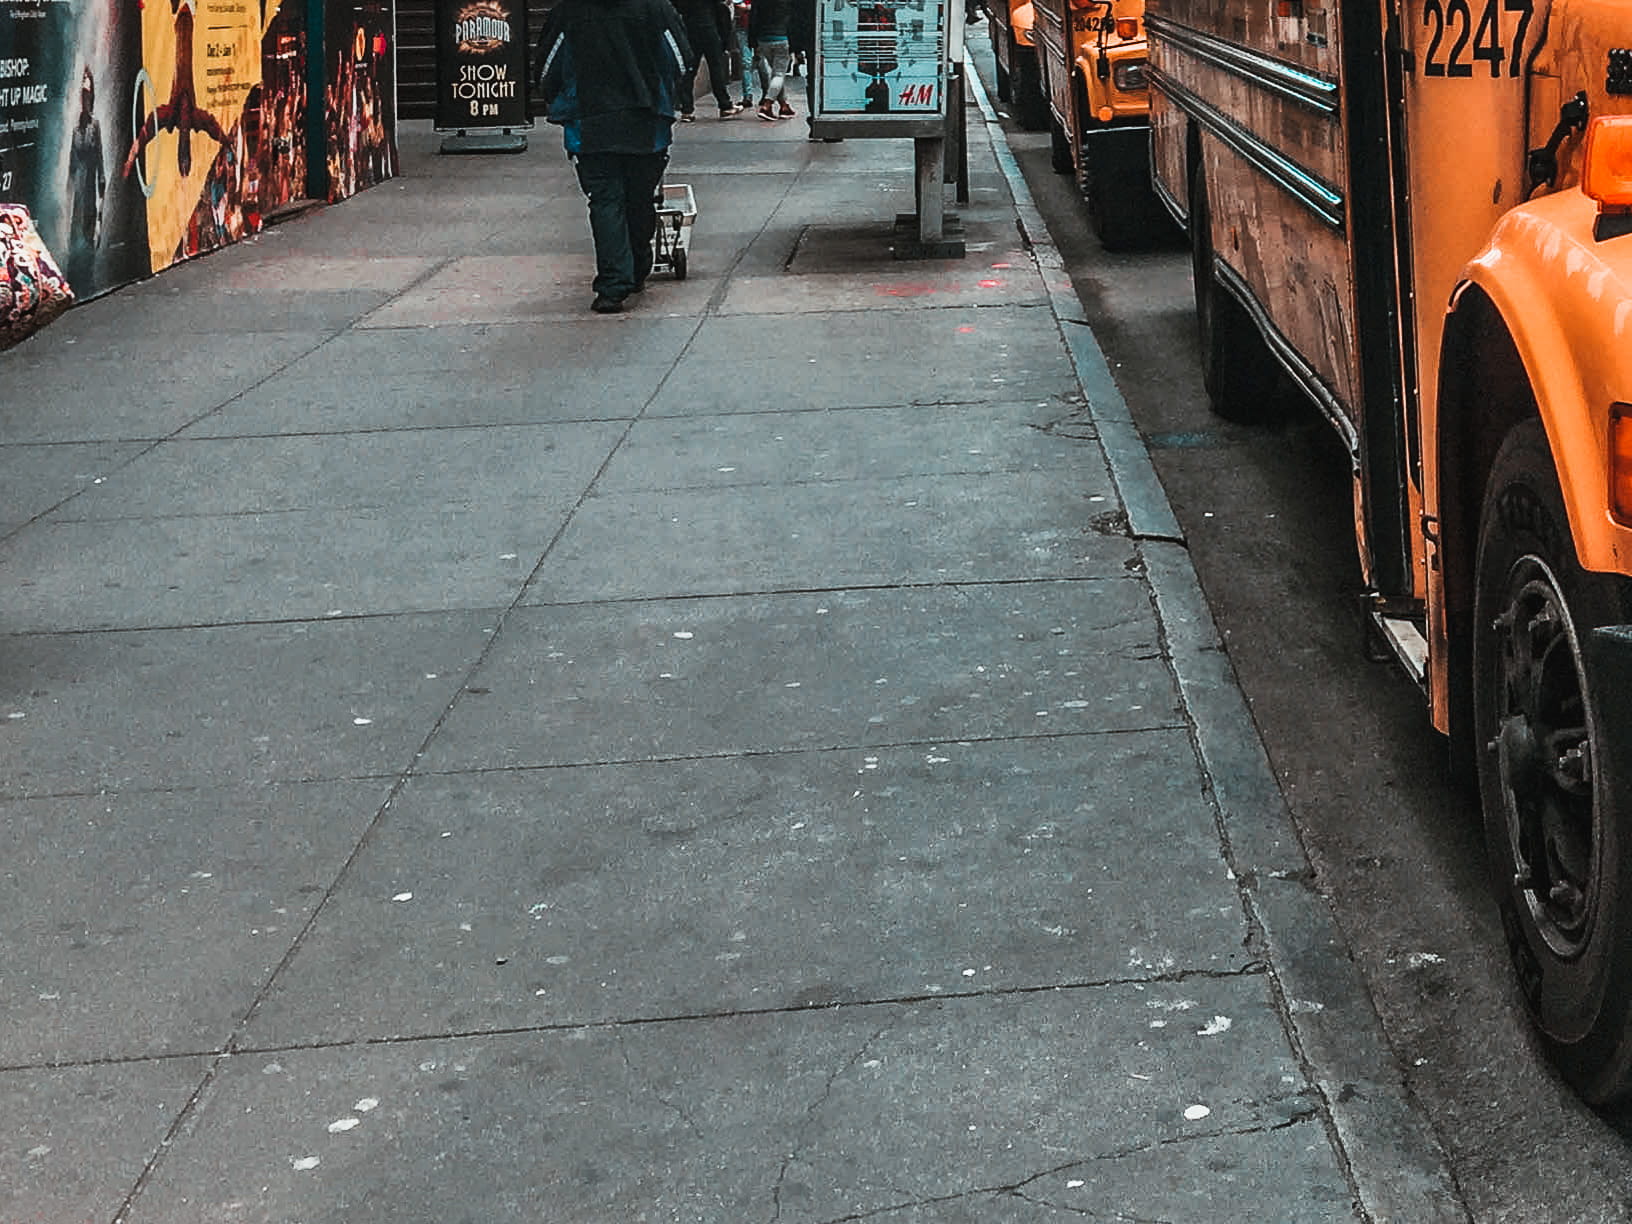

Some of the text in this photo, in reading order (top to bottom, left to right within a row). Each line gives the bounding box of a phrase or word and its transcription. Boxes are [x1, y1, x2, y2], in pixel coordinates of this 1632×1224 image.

[455, 16, 511, 44] PARAMOUR
[459, 64, 507, 82] SHOW
[23, 83, 48, 104] MAGIC
[451, 81, 516, 99] TONIGHT
[470, 99, 499, 116] 8 PM
